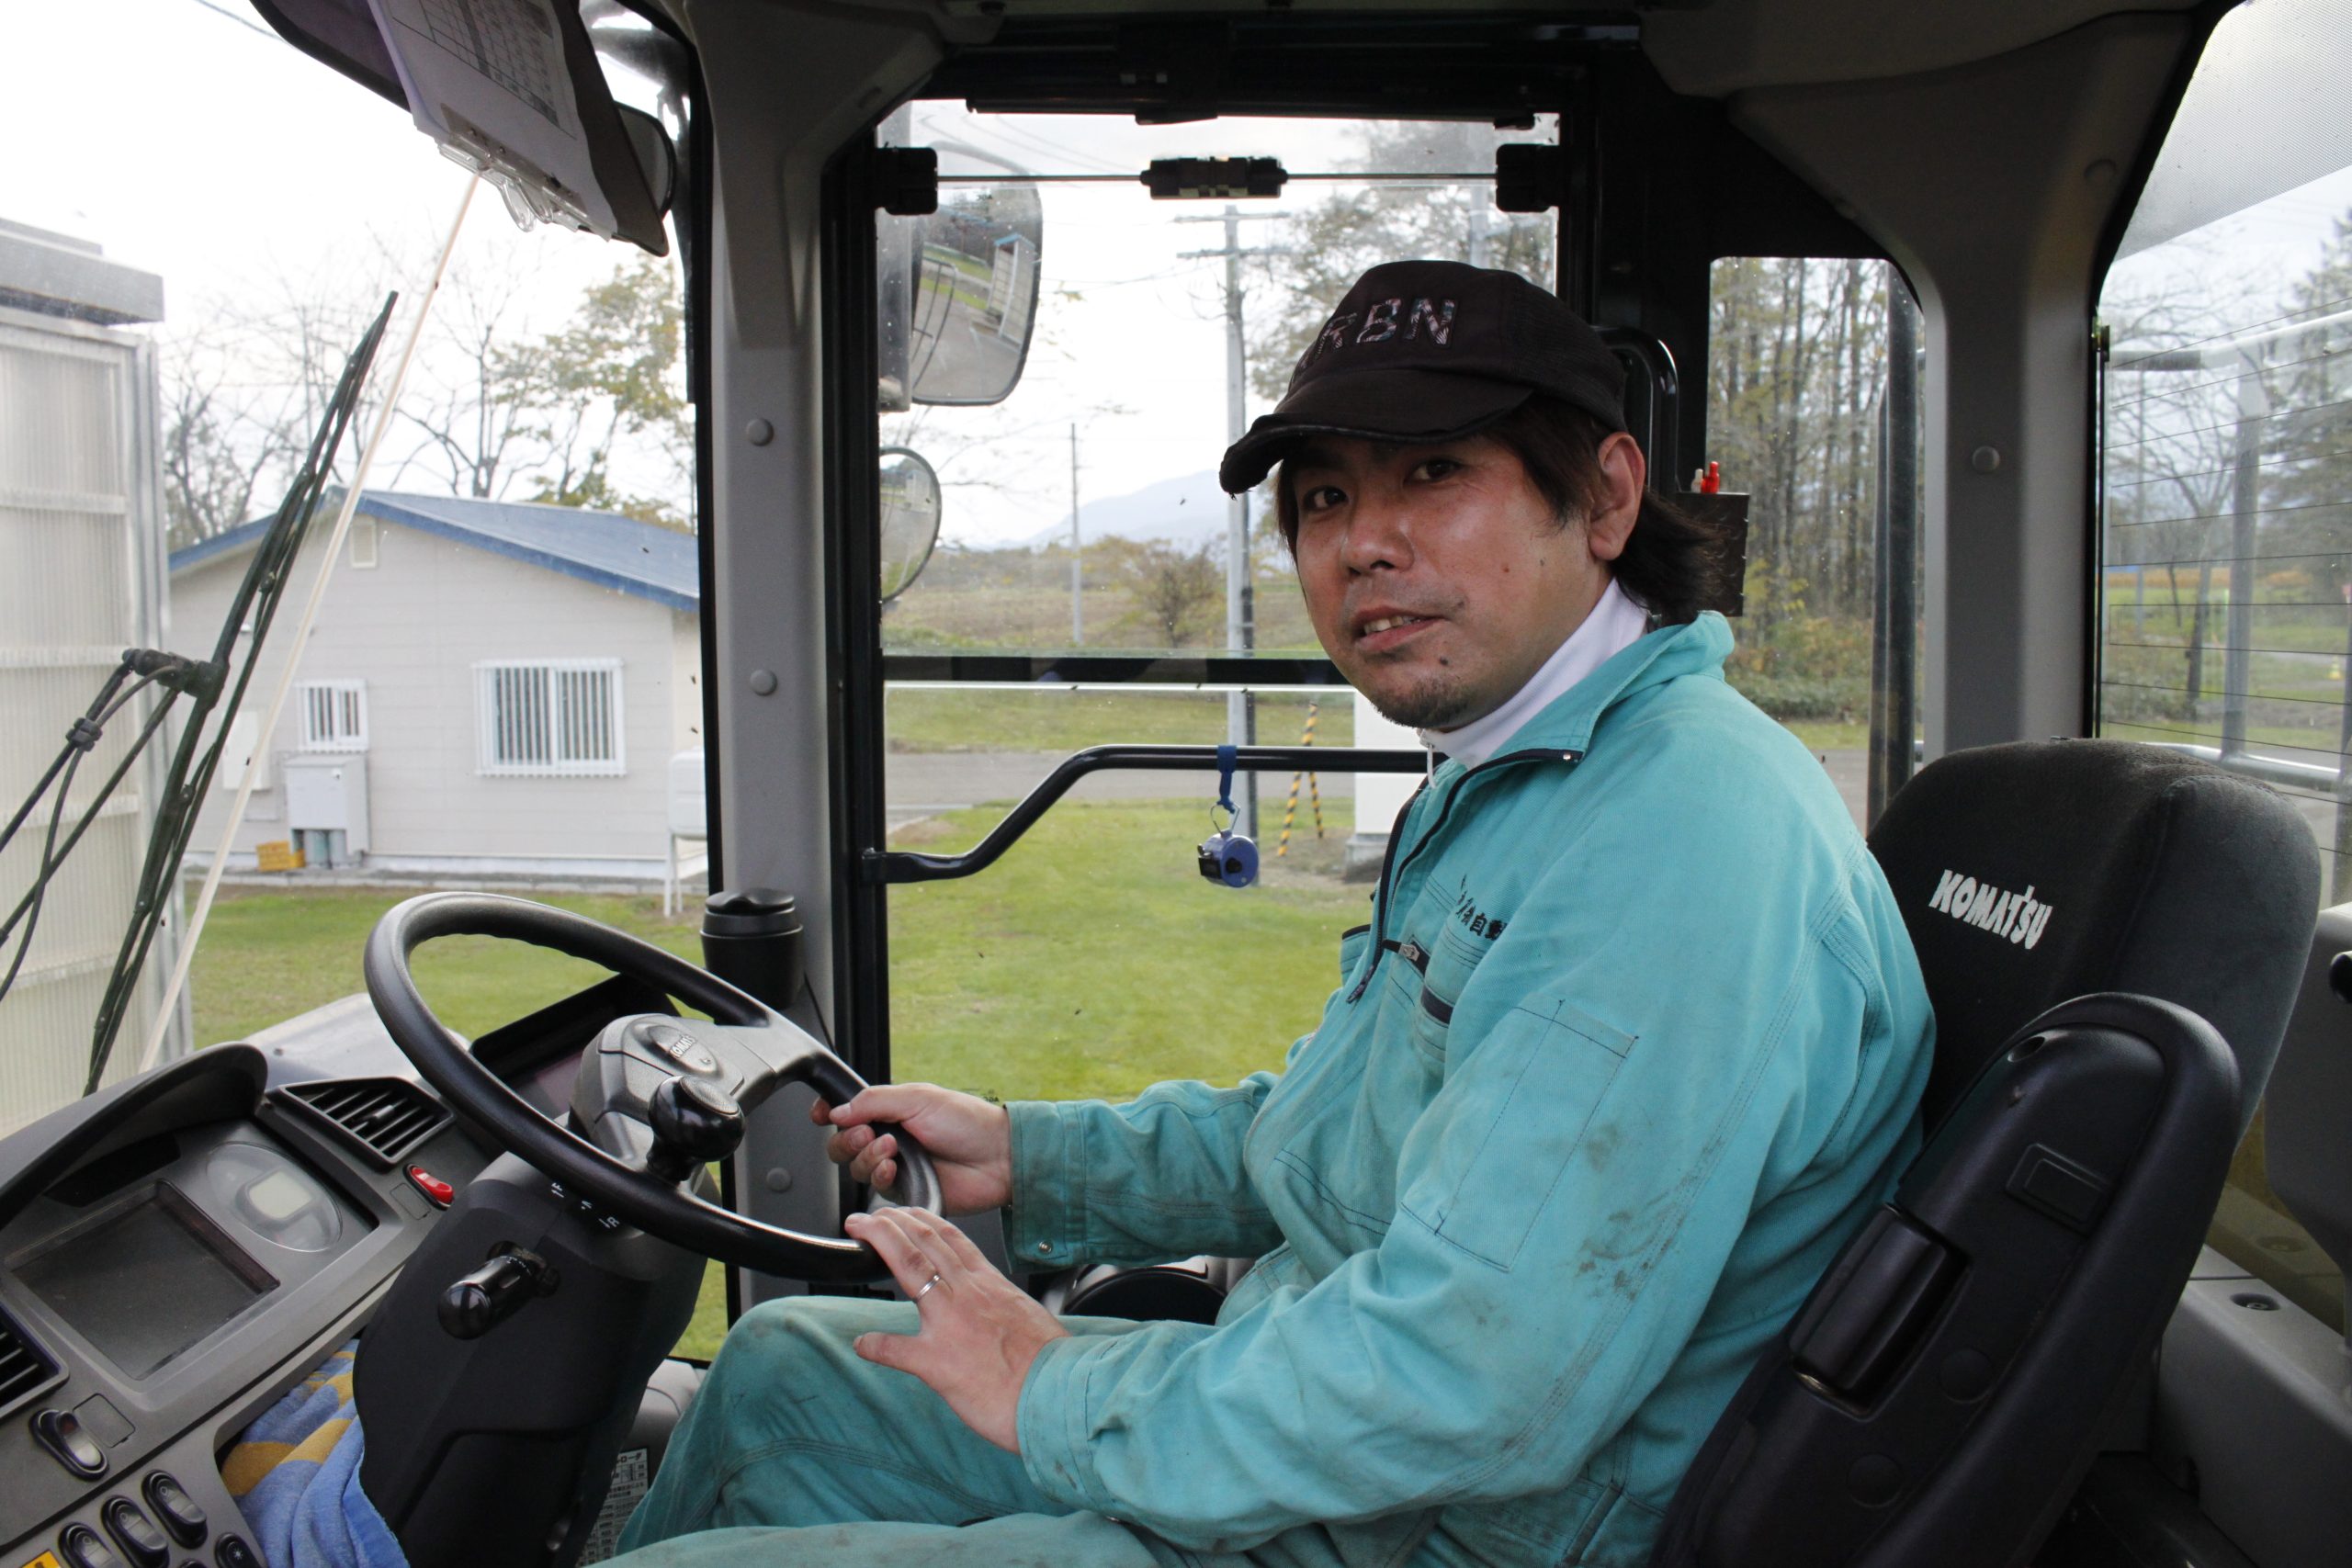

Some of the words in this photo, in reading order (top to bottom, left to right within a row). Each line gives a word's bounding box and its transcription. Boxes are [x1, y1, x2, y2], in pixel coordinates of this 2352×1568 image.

[1297, 298, 1456, 369] RBN
[1928, 869, 2053, 950] KOMATSU
[606, 1216, 620, 1227] R
